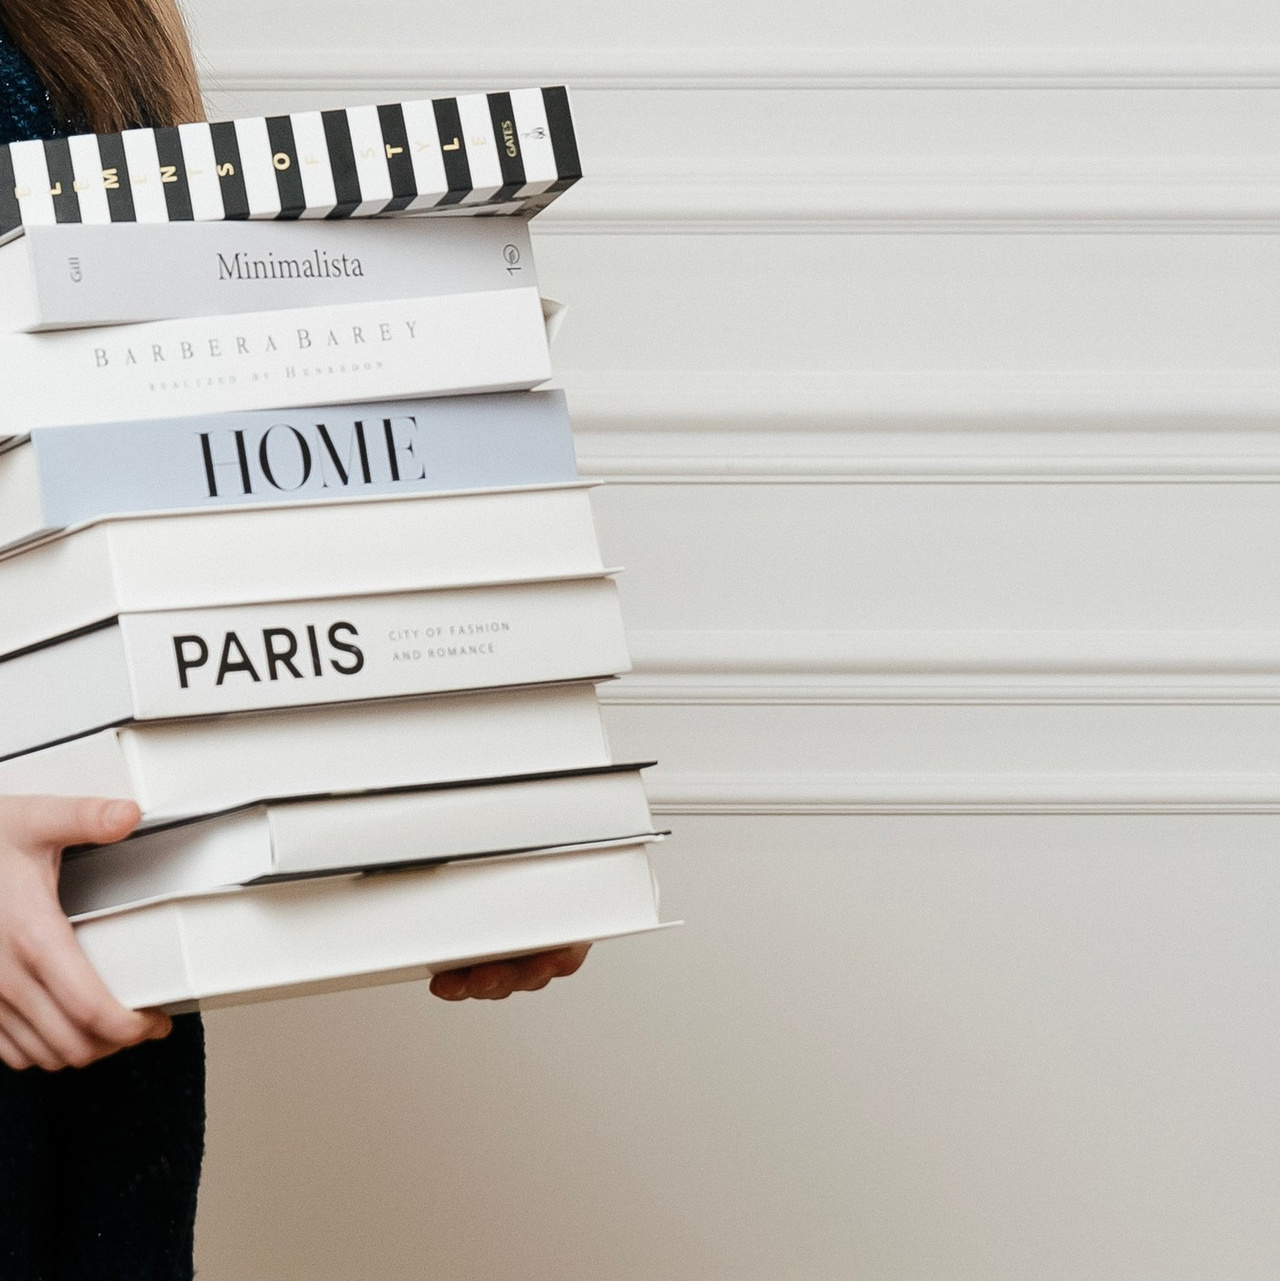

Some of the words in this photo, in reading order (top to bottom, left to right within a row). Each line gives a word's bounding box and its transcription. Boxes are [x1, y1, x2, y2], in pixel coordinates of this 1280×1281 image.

[502, 120, 518, 158] GATES
[69, 256, 83, 283] Gill
[216, 249, 364, 280] Minimalista
[195, 416, 426, 497] HOME
[388, 629, 418, 641] CITY
[425, 627, 442, 638] OF
[449, 622, 510, 636] FASHION
[173, 621, 364, 688] PARIS
[393, 650, 422, 661] AND
[427, 643, 494, 658] ROMANCE
